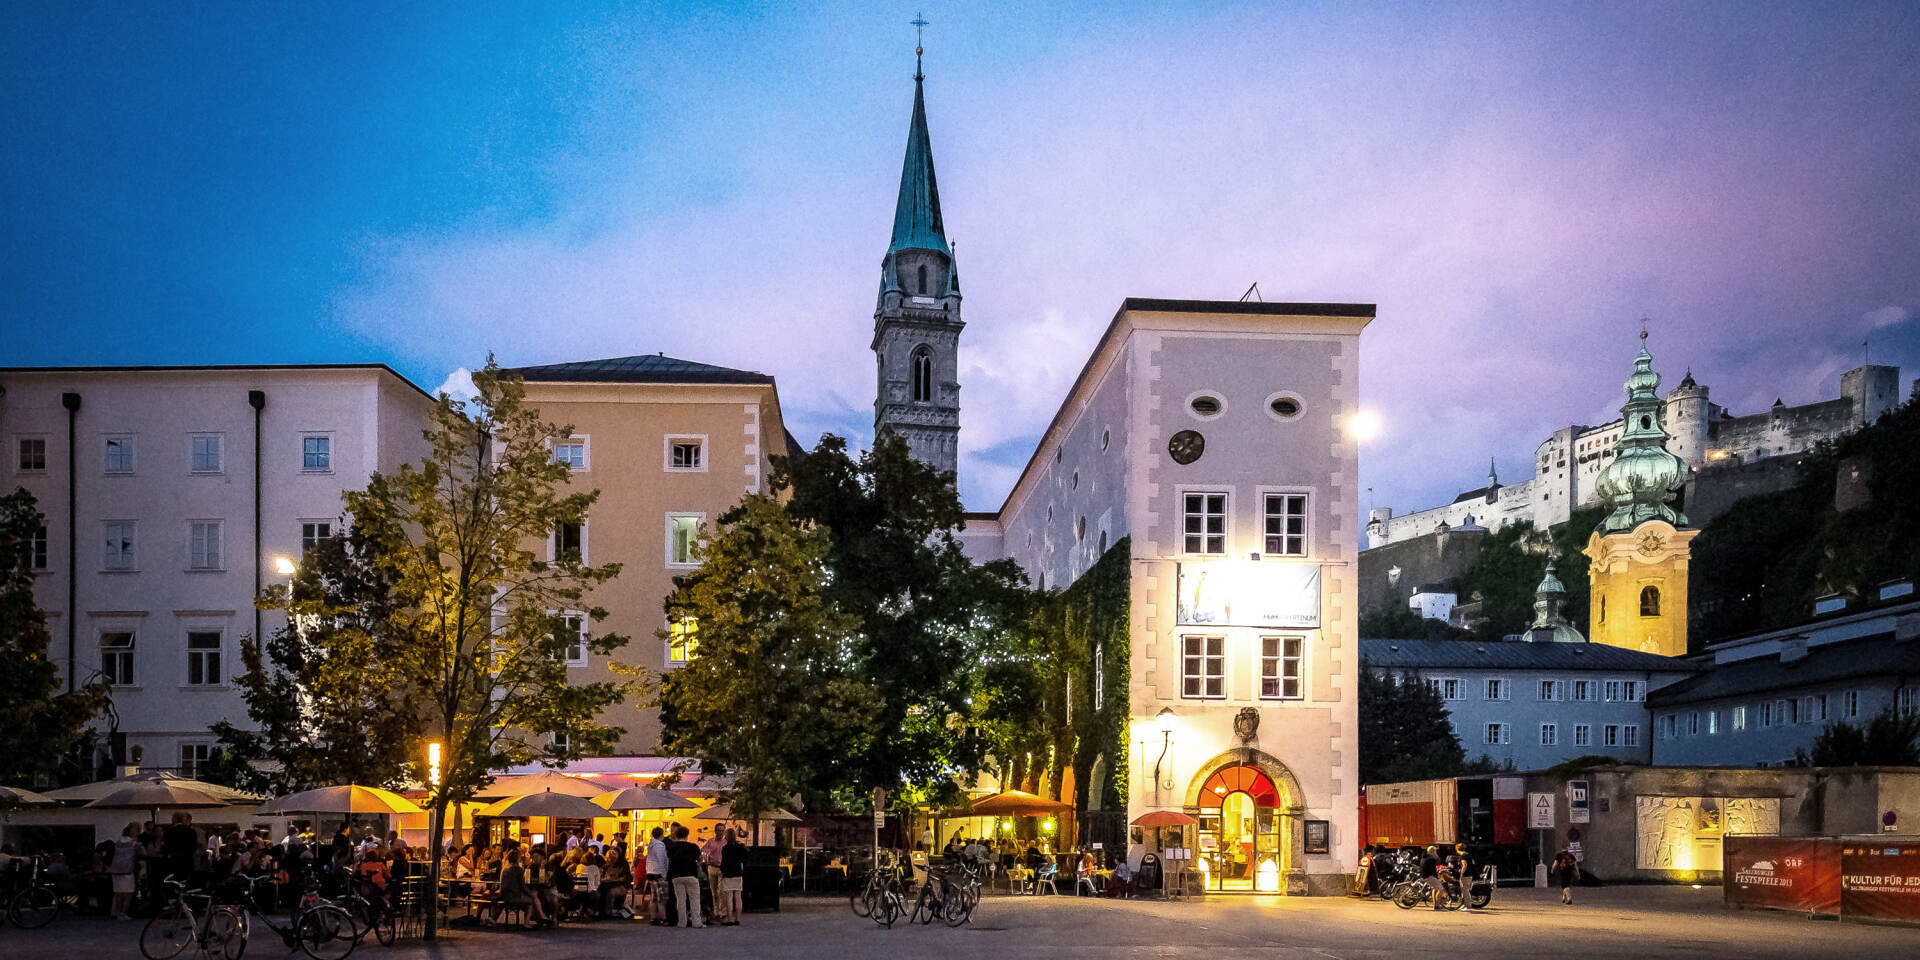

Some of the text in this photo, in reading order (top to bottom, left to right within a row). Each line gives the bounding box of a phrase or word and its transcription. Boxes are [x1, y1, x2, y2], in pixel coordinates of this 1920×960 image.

[1785, 859, 1803, 868] ORF
[1735, 872, 1793, 887] FESTSPIELE 2013
[1850, 875, 1882, 885] KULTUR
[1884, 874, 1902, 886] FÜR
